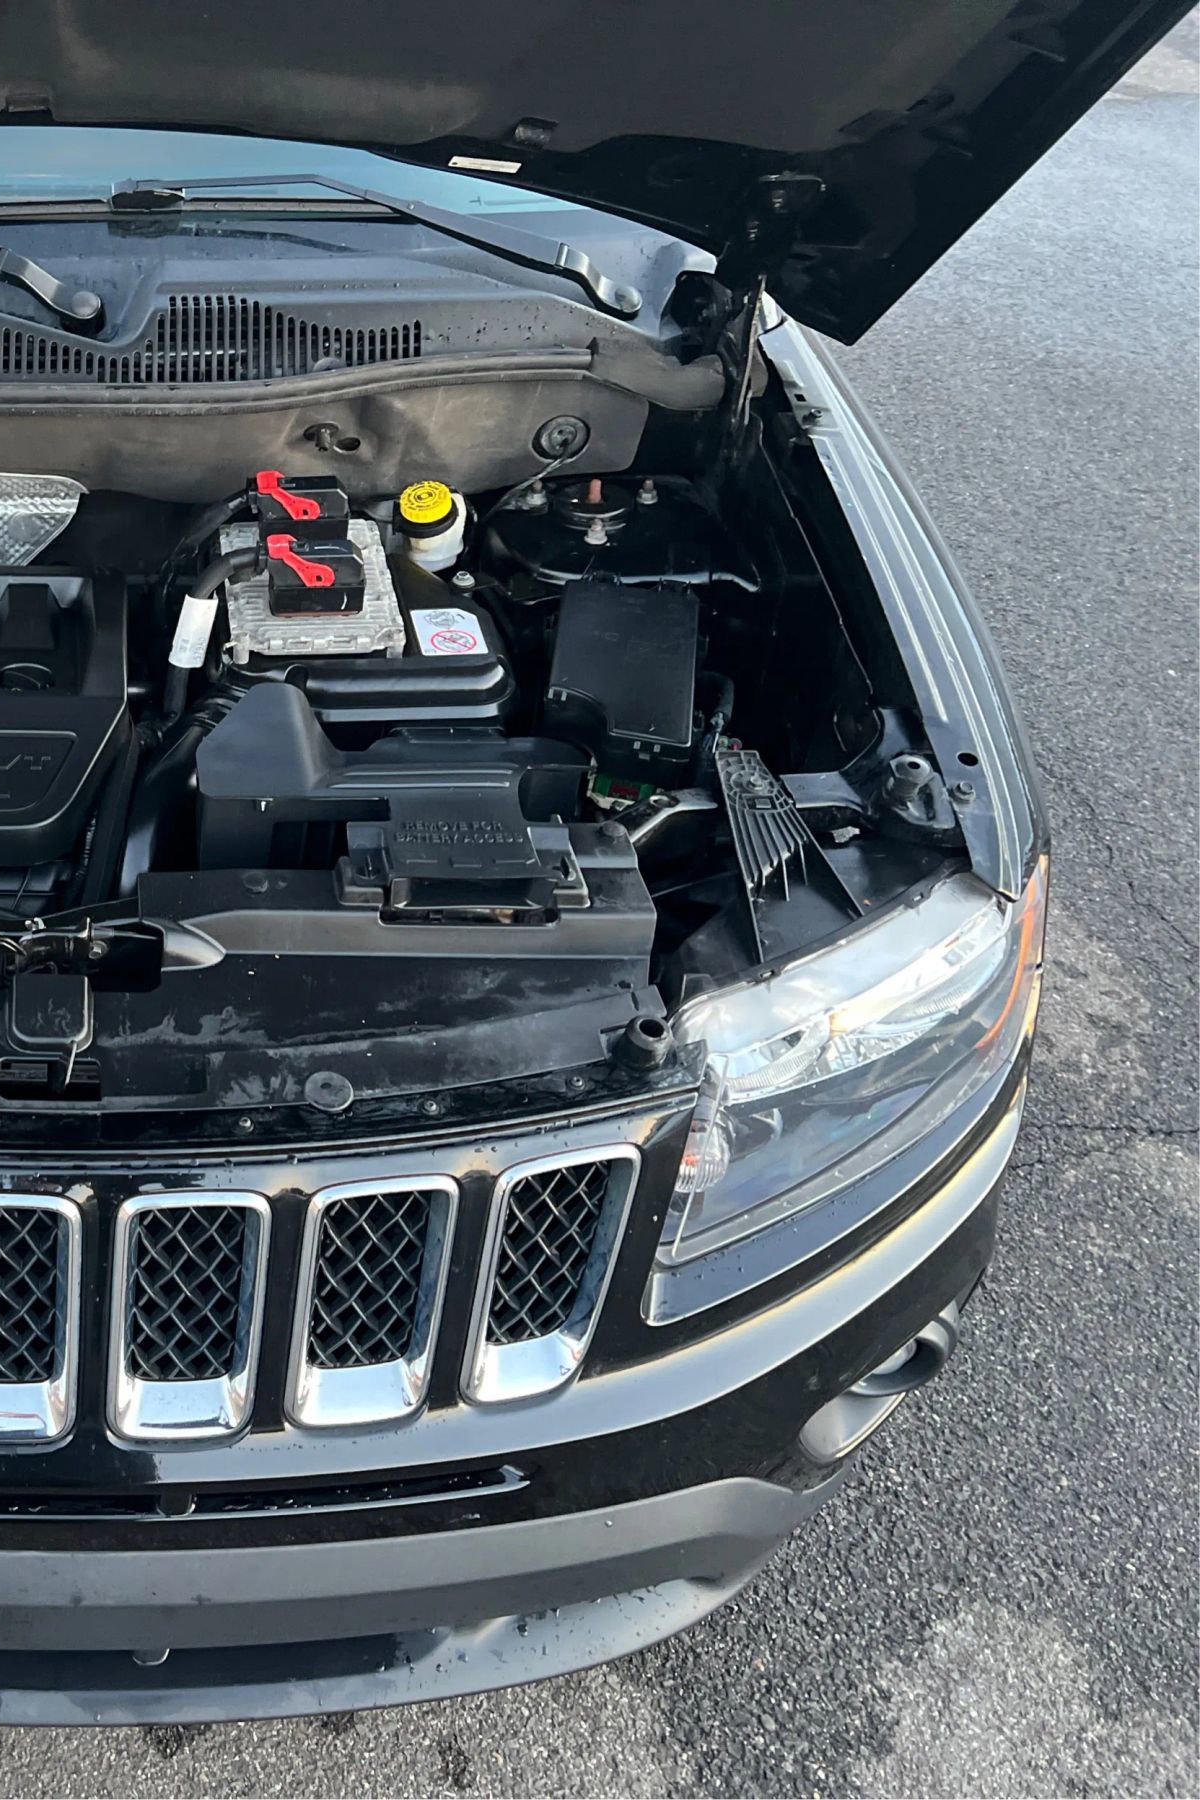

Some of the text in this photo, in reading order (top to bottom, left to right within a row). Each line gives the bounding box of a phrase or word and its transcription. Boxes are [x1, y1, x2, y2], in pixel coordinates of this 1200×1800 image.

[402, 820, 504, 832] REMOVE FOR
[395, 832, 524, 844] BATTERY ACCESS
